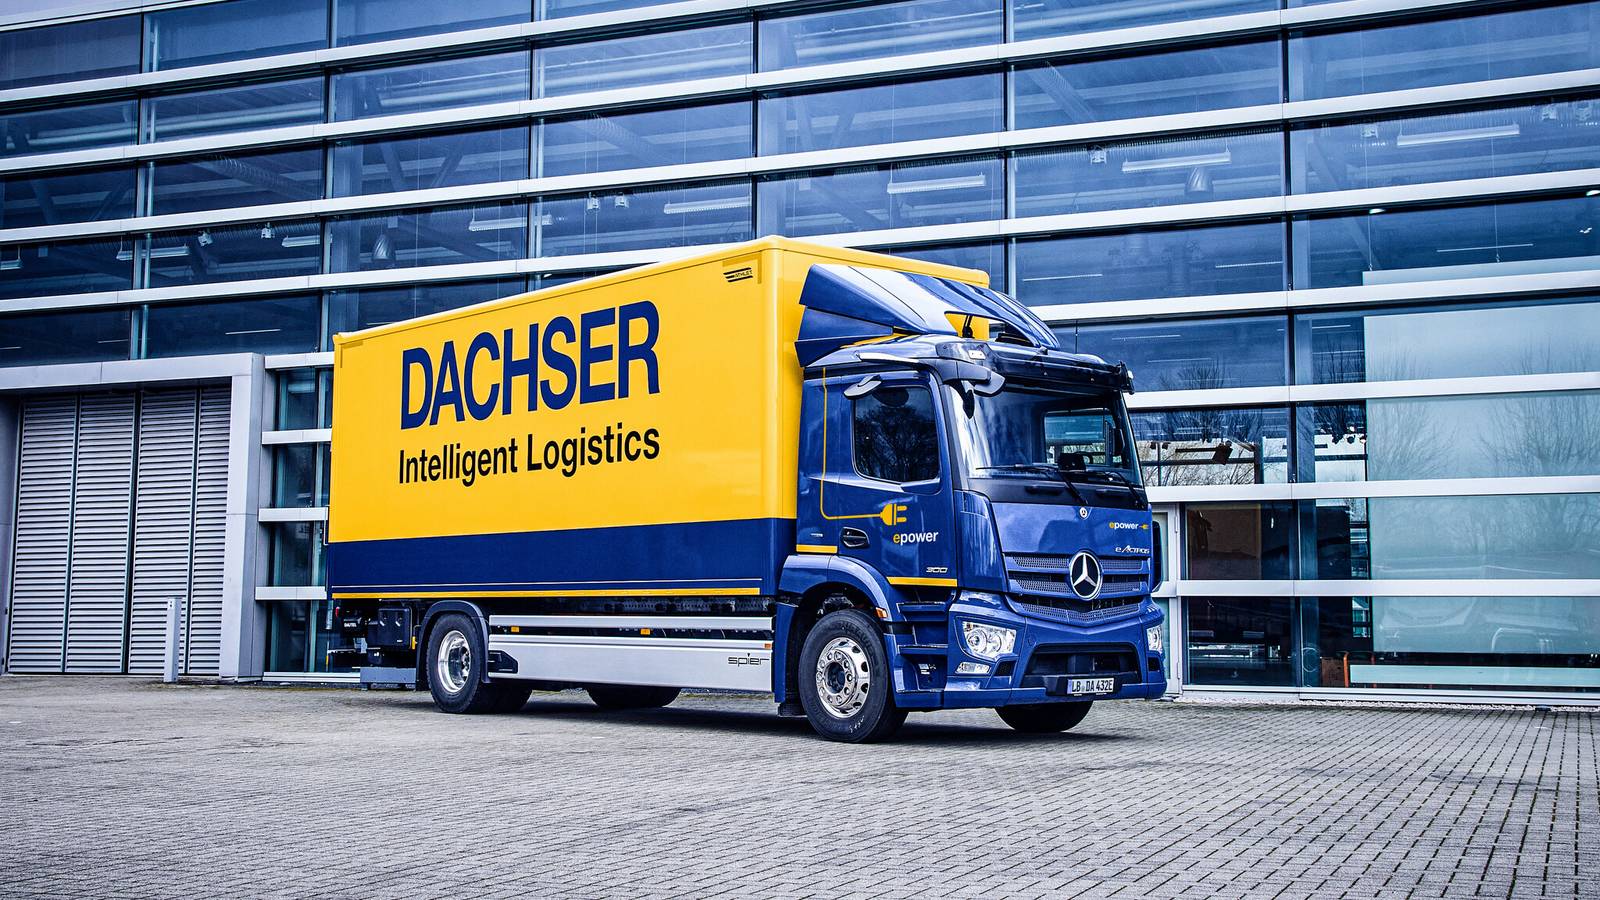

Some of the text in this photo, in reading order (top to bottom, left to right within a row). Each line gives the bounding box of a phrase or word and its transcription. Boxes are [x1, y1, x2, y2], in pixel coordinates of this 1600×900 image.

[401, 300, 660, 430] DACHSER
[399, 422, 660, 487] Intelligent Logistics
[893, 532, 939, 546] epower
[728, 653, 770, 667] spier
[1072, 681, 1081, 692] LB
[1086, 680, 1095, 692] DA
